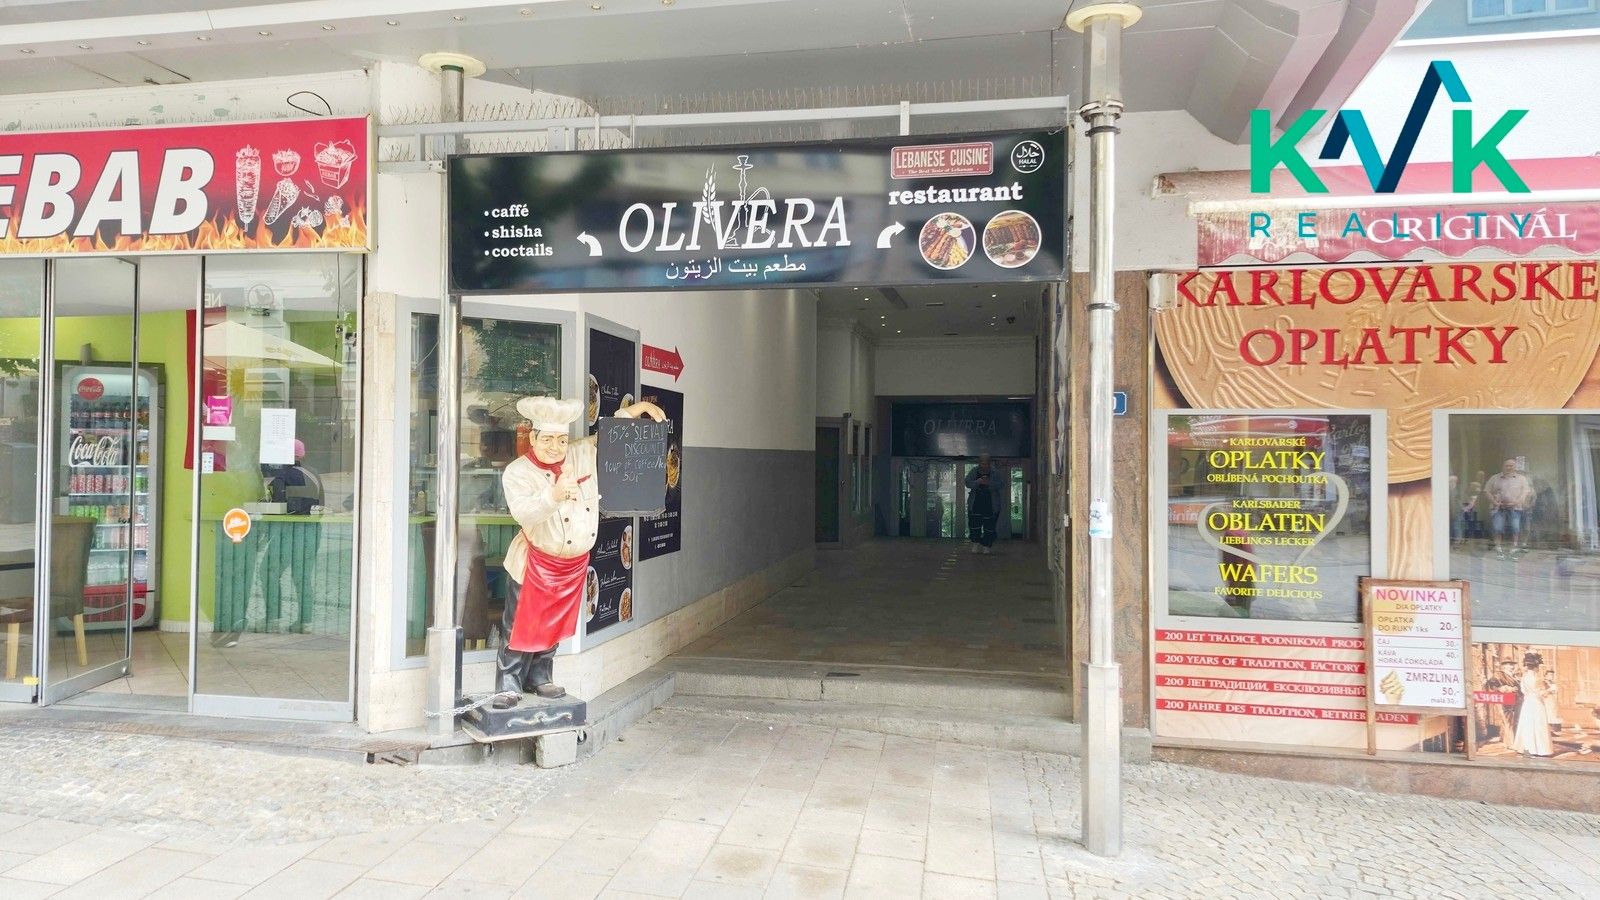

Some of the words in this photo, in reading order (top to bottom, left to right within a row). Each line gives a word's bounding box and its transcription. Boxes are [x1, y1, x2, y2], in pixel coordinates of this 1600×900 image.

[896, 149, 946, 169] LEBANESE
[950, 147, 989, 167] CUISINE
[888, 182, 1024, 206] restaurant
[491, 203, 530, 218] caffé
[491, 225, 543, 239] shisha
[618, 196, 851, 255] OLIVERA
[1366, 206, 1577, 244] ORIGINÁL
[491, 243, 554, 258] coctails
[666, 256, 723, 281] الزيتون
[728, 260, 759, 277] بيت
[763, 257, 807, 277] مطعم
[1239, 323, 1519, 367] OPLATKY
[922, 418, 998, 437] OLIVERA
[68, 435, 121, 467] Coca-Cola
[1230, 437, 1306, 447] KARLOVARSKÉ
[1209, 450, 1325, 470] OPLATKY
[1206, 472, 1259, 483] OBLÍBENÁ
[1261, 474, 1328, 484] POCHOUTKA
[1233, 500, 1301, 510] KARLSBADER
[1208, 512, 1325, 532] OBLATEN
[1219, 536, 1272, 546] LIEBLINGS
[1274, 536, 1316, 547] LECKER
[1218, 563, 1318, 585] WAFERS
[1214, 586, 1264, 597] FAVORITE
[1266, 588, 1323, 599] DELICIOUS
[1376, 589, 1448, 602] NOVINKA
[1164, 632, 1183, 640] 200
[1186, 633, 1205, 642] LET
[1207, 634, 1259, 645] TRADICE,
[1261, 636, 1328, 647] PODNIKOVÁ
[1331, 638, 1366, 648] PROD
[1164, 655, 1183, 663] 200
[1186, 656, 1219, 665] YEARS
[1222, 657, 1238, 665] OF
[1241, 658, 1307, 670] TRADITION,
[1310, 662, 1361, 672] FACTORY
[1405, 672, 1460, 683] ZMRZLINA
[1164, 678, 1184, 686] 200
[1186, 679, 1207, 687] ЛЕТ
[1208, 680, 1270, 692] ТРАДИЦИИ,
[1273, 683, 1366, 696] ЕКСКЛЮЗИВНЫЙ
[1164, 701, 1184, 709] 200
[1186, 702, 1222, 712] JAHRE
[1225, 704, 1246, 713] DES
[1251, 706, 1319, 719] TRADITION,
